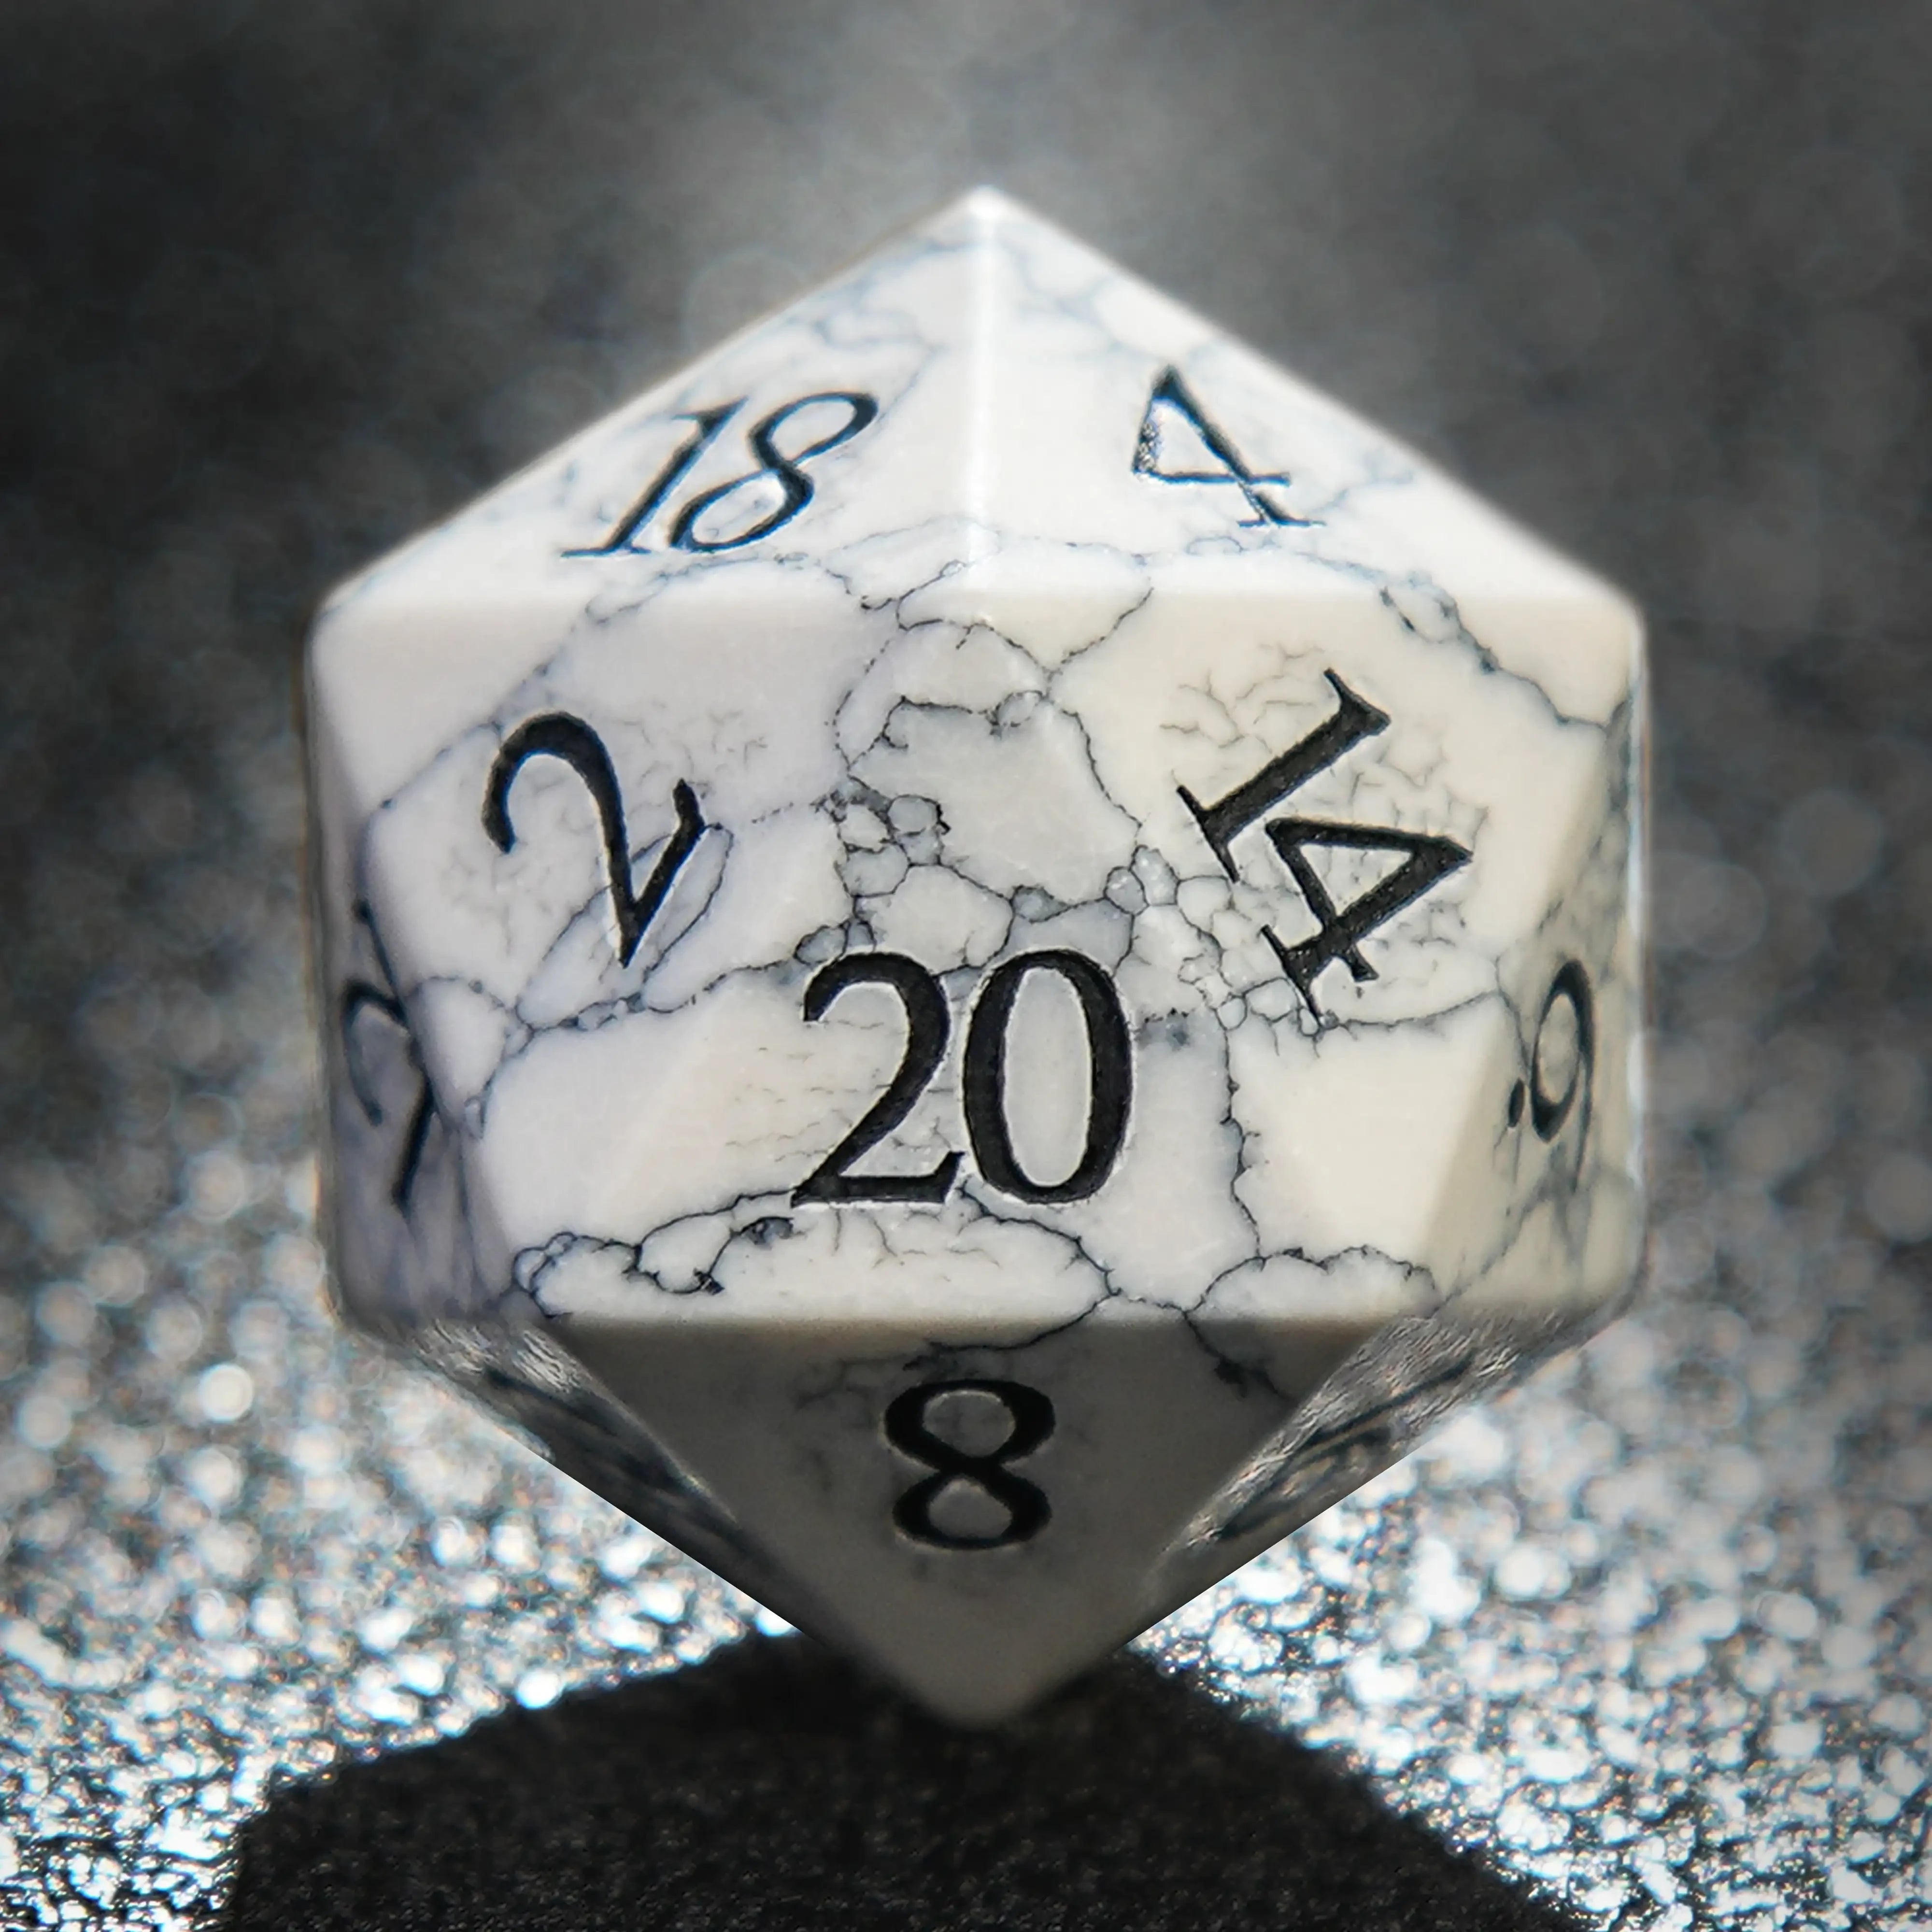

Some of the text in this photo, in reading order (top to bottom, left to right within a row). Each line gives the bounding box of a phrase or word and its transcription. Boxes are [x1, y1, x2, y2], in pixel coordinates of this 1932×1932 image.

[560, 392, 879, 558] 18
[1132, 364, 1325, 527] 4
[483, 710, 706, 968] 2
[1176, 667, 1473, 1026] 14
[791, 948, 1133, 1207] 20
[884, 1378, 1056, 1549] 8
